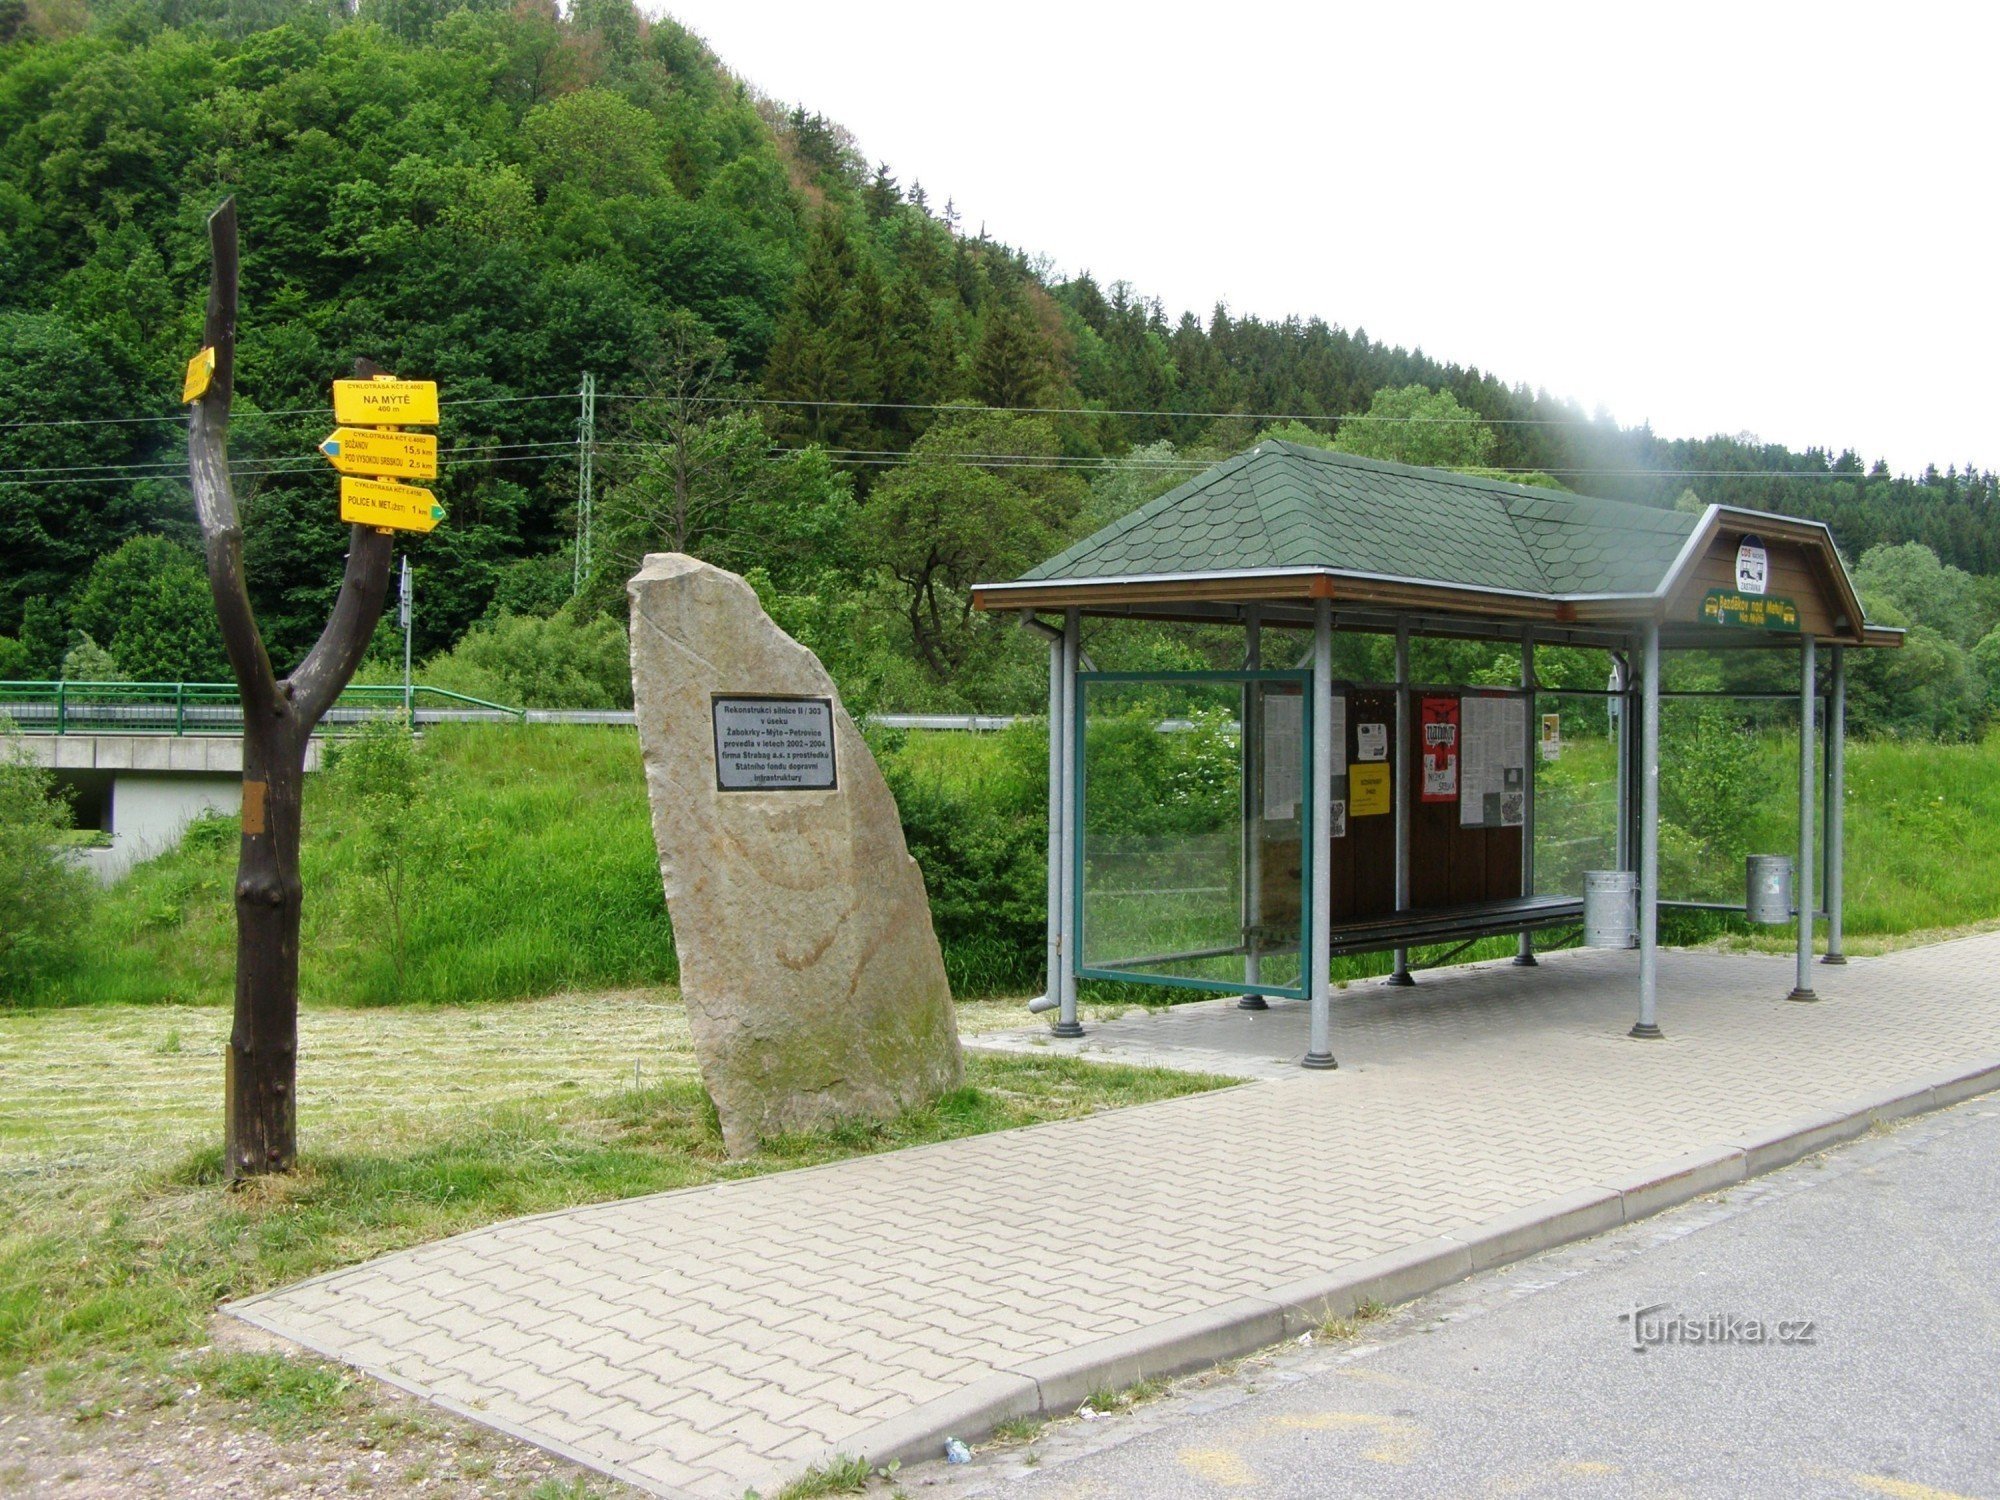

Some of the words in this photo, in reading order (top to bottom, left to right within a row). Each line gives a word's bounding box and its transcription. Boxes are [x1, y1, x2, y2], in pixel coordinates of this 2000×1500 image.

[364, 396, 378, 404] NA
[354, 432, 394, 440] CYKLOTRASA
[344, 440, 368, 450] BOŽANOV
[404, 445, 420, 454] 15,5
[344, 454, 356, 462] POD
[409, 460, 420, 468] 2,5
[354, 482, 392, 492] CYKLOTRASA
[348, 496, 370, 507] POLICE
[371, 499, 377, 507] N.
[412, 506, 416, 514] 1
[724, 706, 772, 715] Rekonstrukci
[774, 706, 797, 715] silnice
[767, 717, 788, 725] úseku
[727, 727, 760, 737] Žabokrky
[766, 728, 784, 737] Mýto
[724, 740, 754, 748] provedla
[743, 752, 771, 760] Strabag
[736, 762, 766, 770] Státního
[767, 762, 787, 770] fondu
[788, 763, 819, 771] dopravní
[754, 774, 802, 782] infrastruktury
